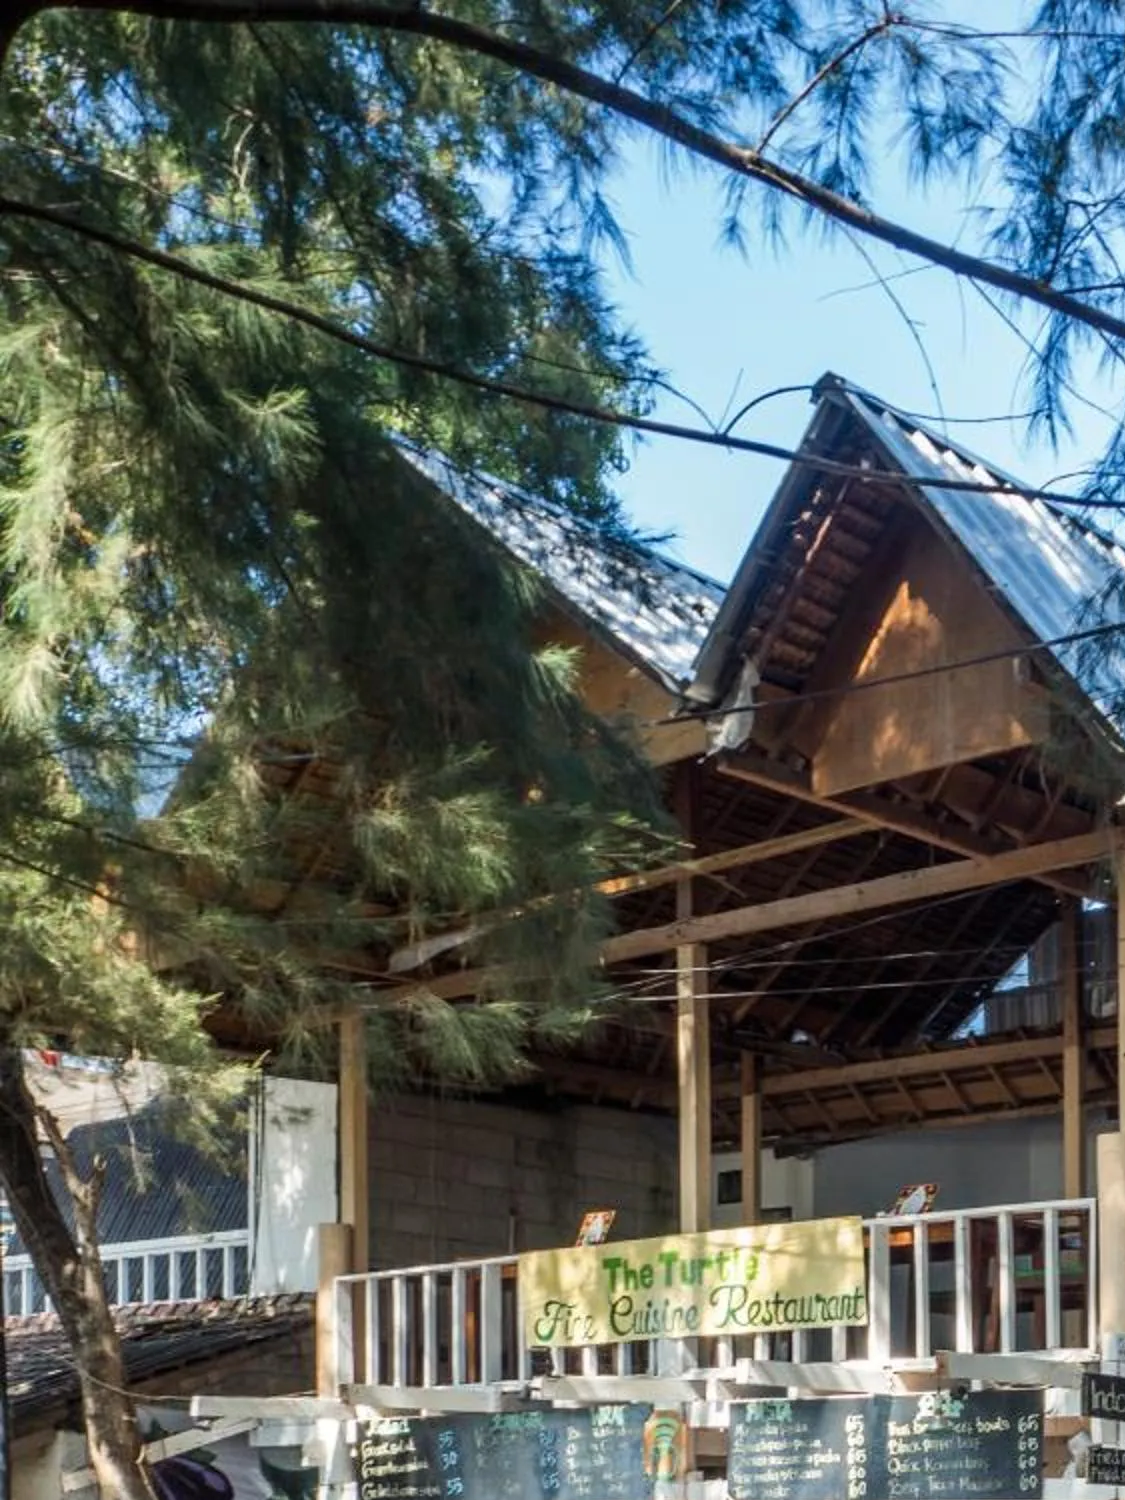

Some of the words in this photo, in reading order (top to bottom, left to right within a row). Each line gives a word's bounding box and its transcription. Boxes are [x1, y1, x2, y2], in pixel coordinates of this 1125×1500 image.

[602, 1257, 654, 1293] The
[610, 1295, 699, 1336] Cuisine
[710, 1285, 866, 1328] Restaurant
